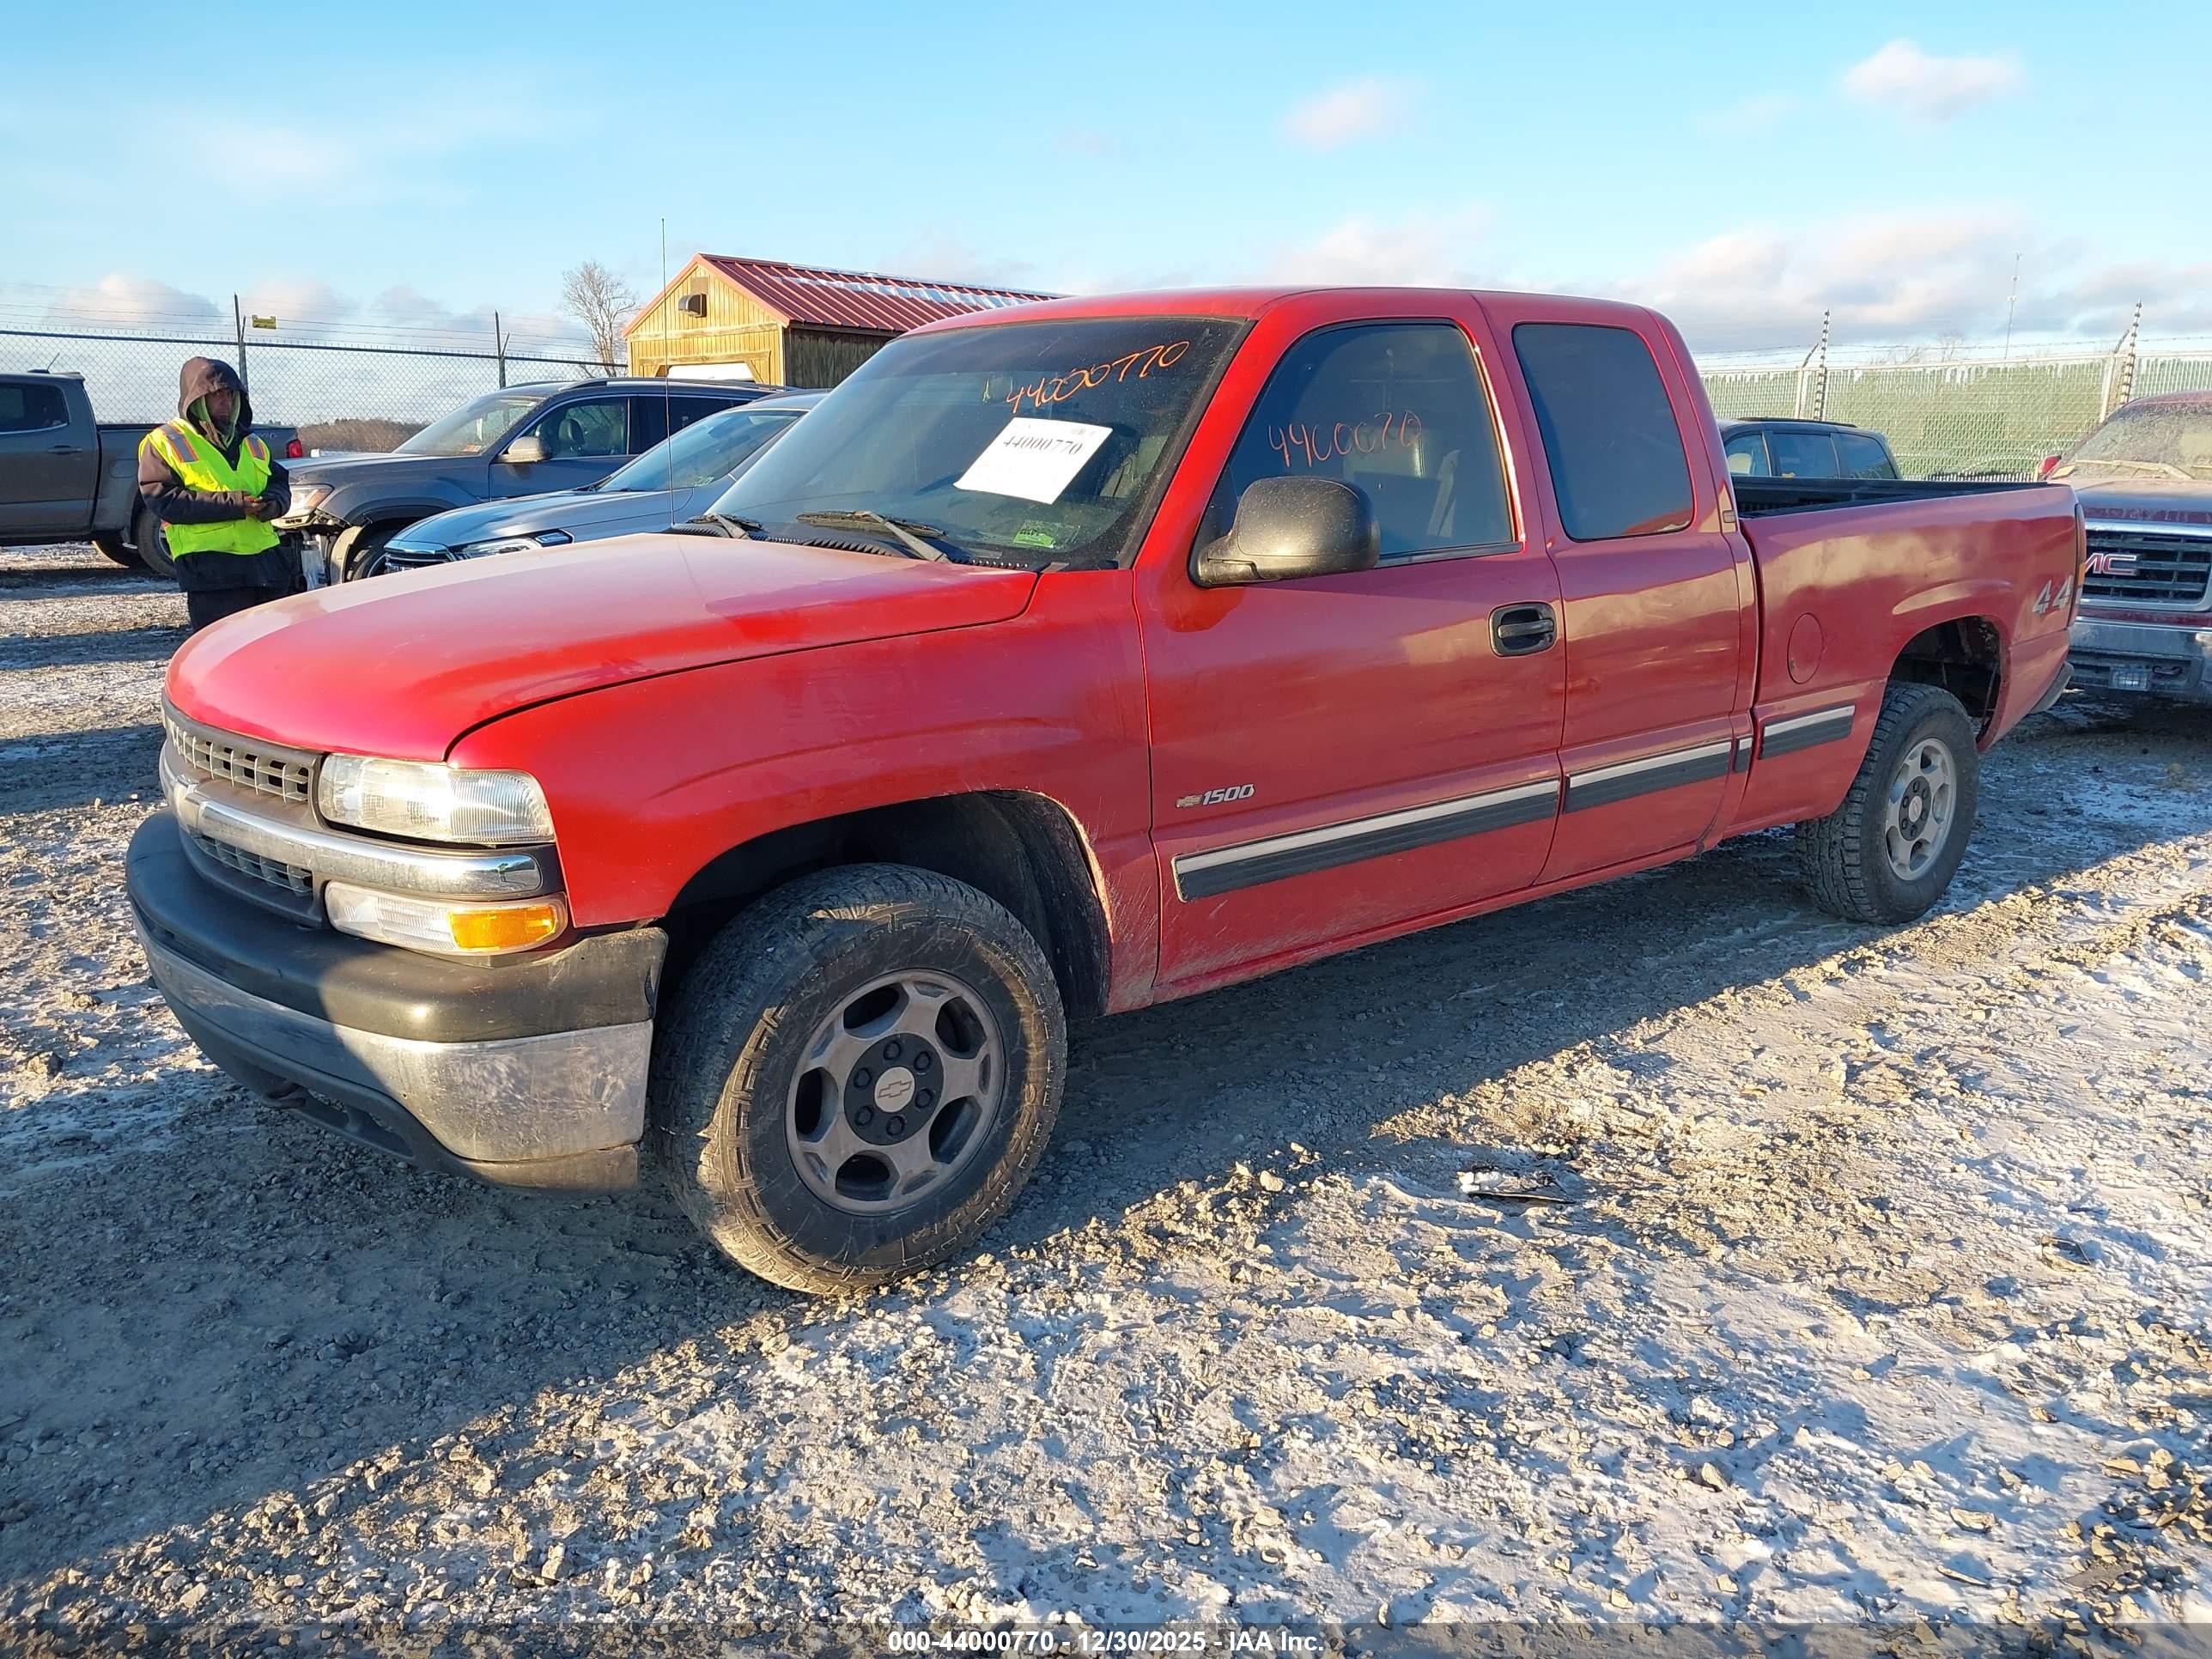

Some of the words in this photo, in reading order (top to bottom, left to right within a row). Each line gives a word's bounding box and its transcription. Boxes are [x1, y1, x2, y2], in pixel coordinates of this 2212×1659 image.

[1006, 341, 1190, 414] 44000770
[1003, 435, 1084, 454] 44000770
[1202, 783, 1255, 805] 1500
